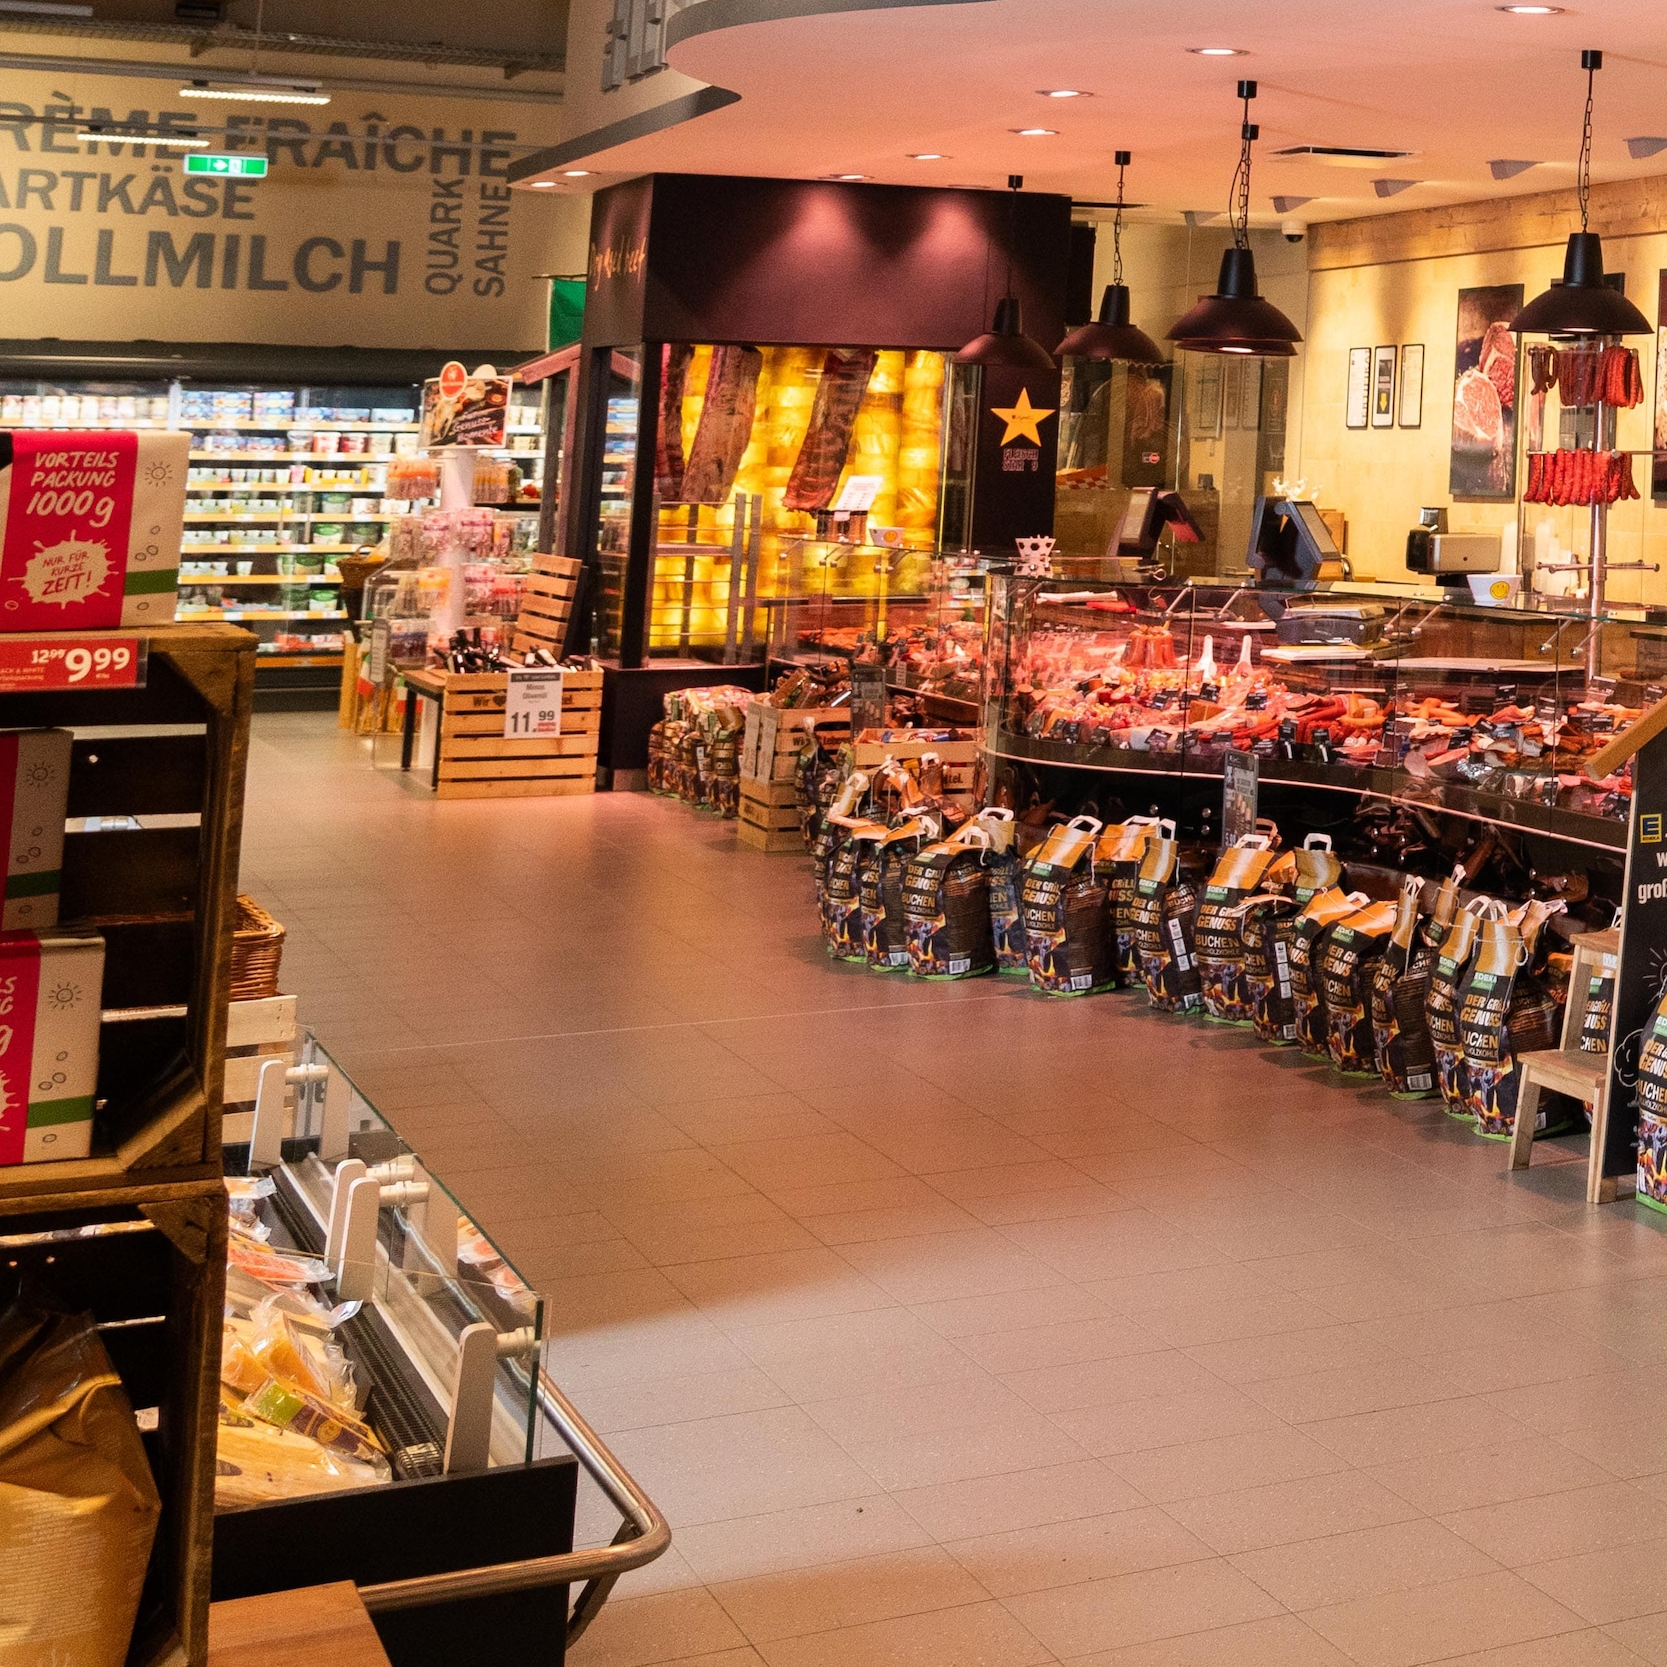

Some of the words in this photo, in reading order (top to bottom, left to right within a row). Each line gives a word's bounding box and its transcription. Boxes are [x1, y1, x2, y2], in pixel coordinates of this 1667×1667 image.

[225, 112, 517, 178] FRAÎCHE
[425, 178, 465, 296] QUARK
[474, 182, 512, 299] SAHNE
[0, 222, 400, 295] OLLMILCH
[34, 451, 118, 469] VORTEILS
[30, 470, 116, 488] PACKUNG
[26, 490, 91, 516] 1000
[41, 554, 67, 569] NUR
[69, 549, 90, 565] FÜR
[51, 562, 85, 578] KURZE
[1197, 916, 1237, 930] GENUSS
[1195, 935, 1240, 948] BUCHEN
[1461, 1007, 1501, 1027] GENUSS
[1644, 1039, 1662, 1054] DER
